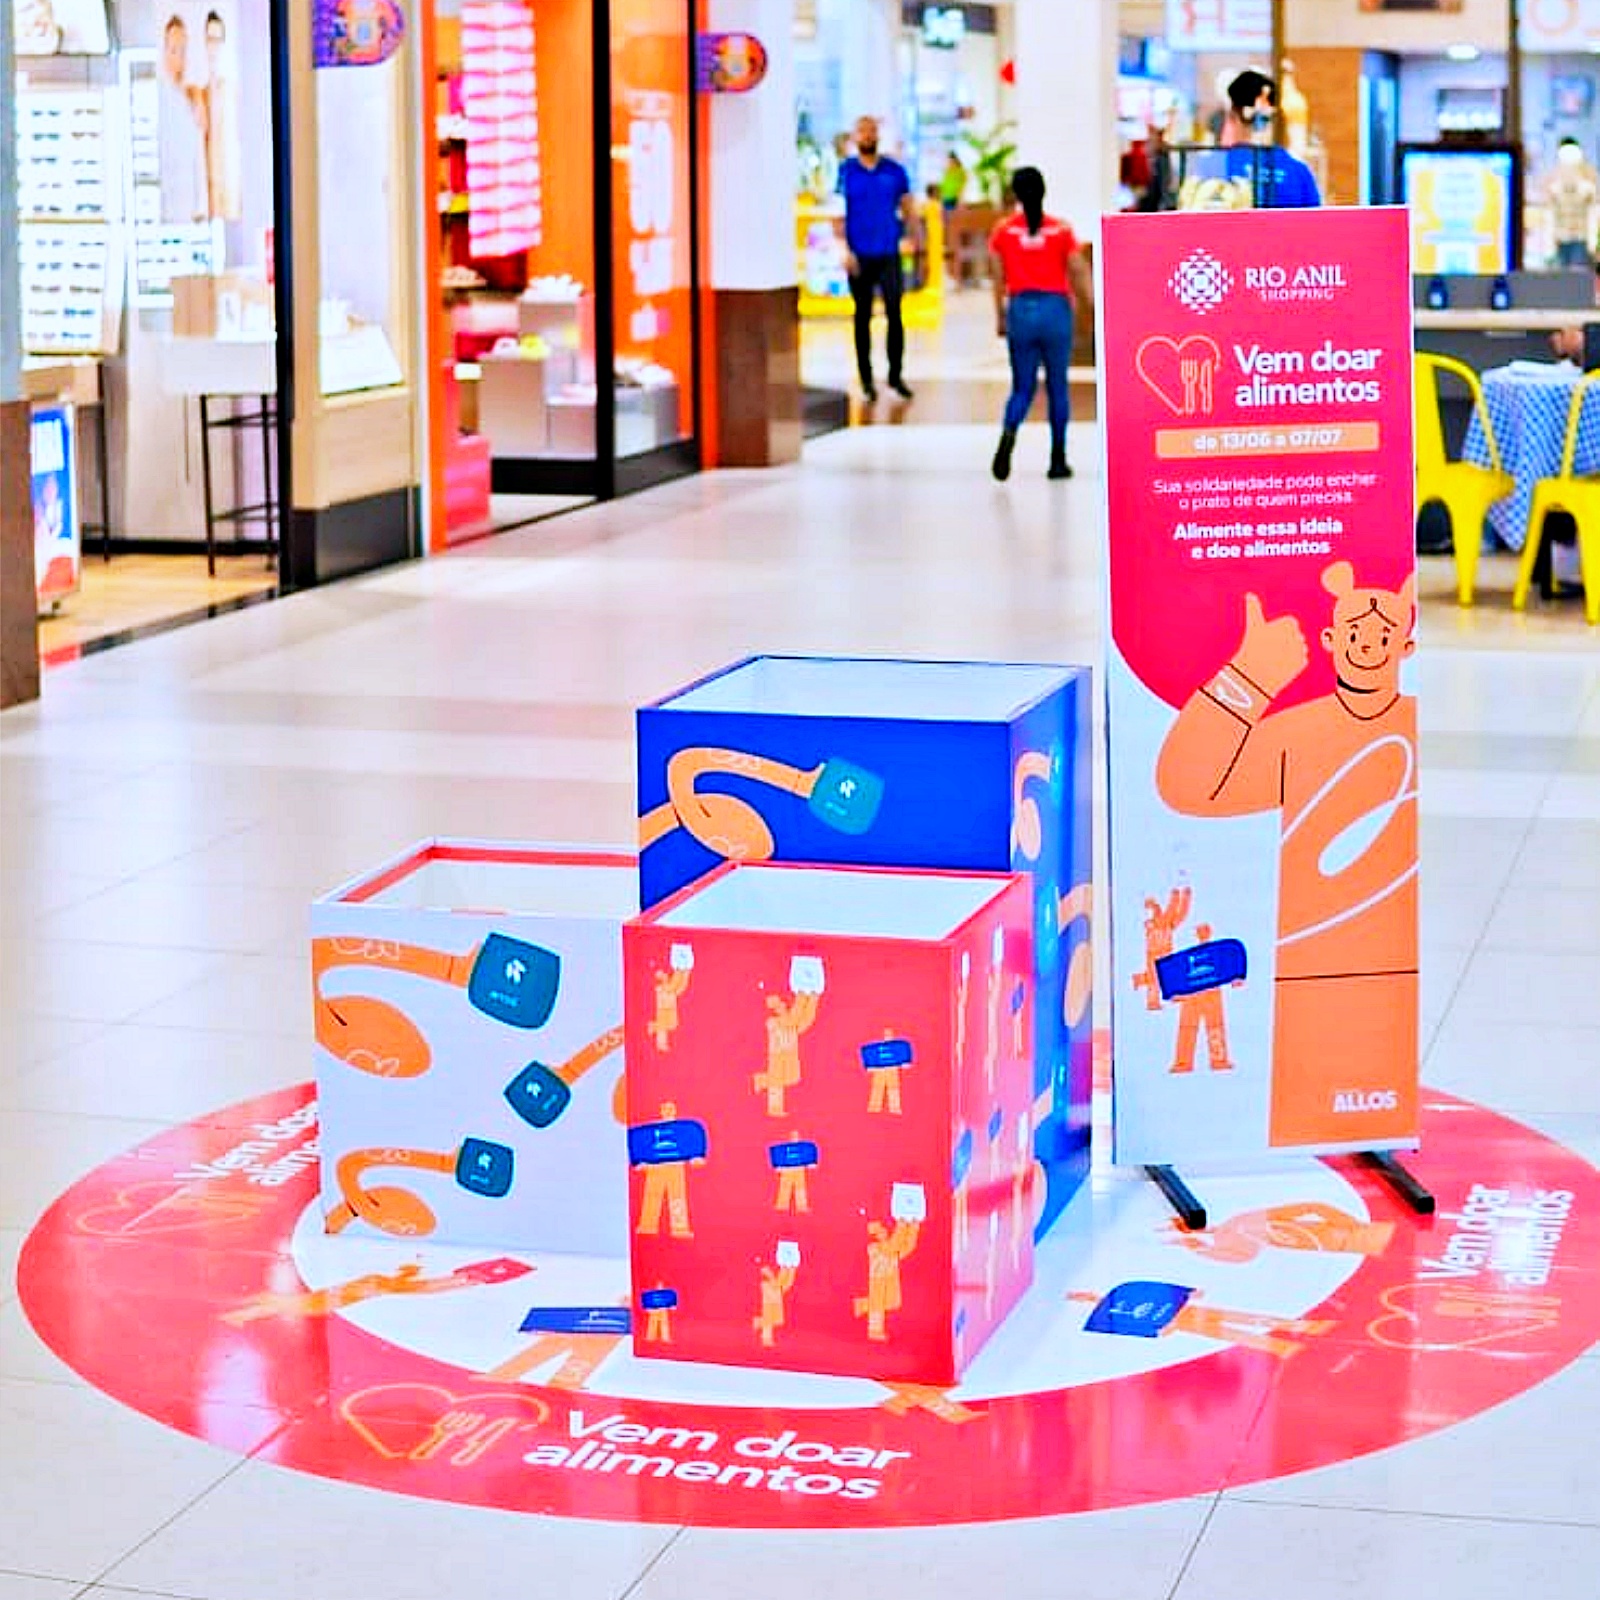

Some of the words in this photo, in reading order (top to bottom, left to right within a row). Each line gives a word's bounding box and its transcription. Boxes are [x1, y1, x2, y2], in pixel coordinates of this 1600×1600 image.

[1245, 267, 1286, 288] RIO
[1292, 264, 1347, 287] ANIL
[1259, 288, 1335, 301] SHOPPING
[1233, 344, 1304, 374] Vem
[1311, 340, 1382, 372] doar
[1234, 375, 1380, 407] alimentos
[1193, 433, 1217, 450] de
[1222, 431, 1271, 449] 13/06
[1274, 434, 1286, 446] a
[1289, 429, 1343, 446] 07/07
[1153, 479, 1182, 494] Sua
[1185, 475, 1283, 492] solidariedade
[1285, 474, 1324, 492] pode
[1326, 472, 1376, 487] encher
[1178, 499, 1189, 510] o
[1192, 494, 1230, 511] prato
[1233, 491, 1252, 507] de
[1256, 493, 1297, 508] quem
[1173, 522, 1253, 540] Alimente
[1256, 522, 1297, 536] essa
[1300, 517, 1343, 534] ideia
[1191, 547, 1203, 559] e
[1206, 543, 1241, 558] doe
[1244, 540, 1331, 557] alimentos
[1333, 1090, 1398, 1113] ALLOS
[173, 1141, 279, 1180] Vem
[1416, 1231, 1493, 1280] Vem
[567, 1410, 719, 1452] Vem
[734, 1430, 912, 1470] doar
[522, 1440, 883, 1500] alimentos
